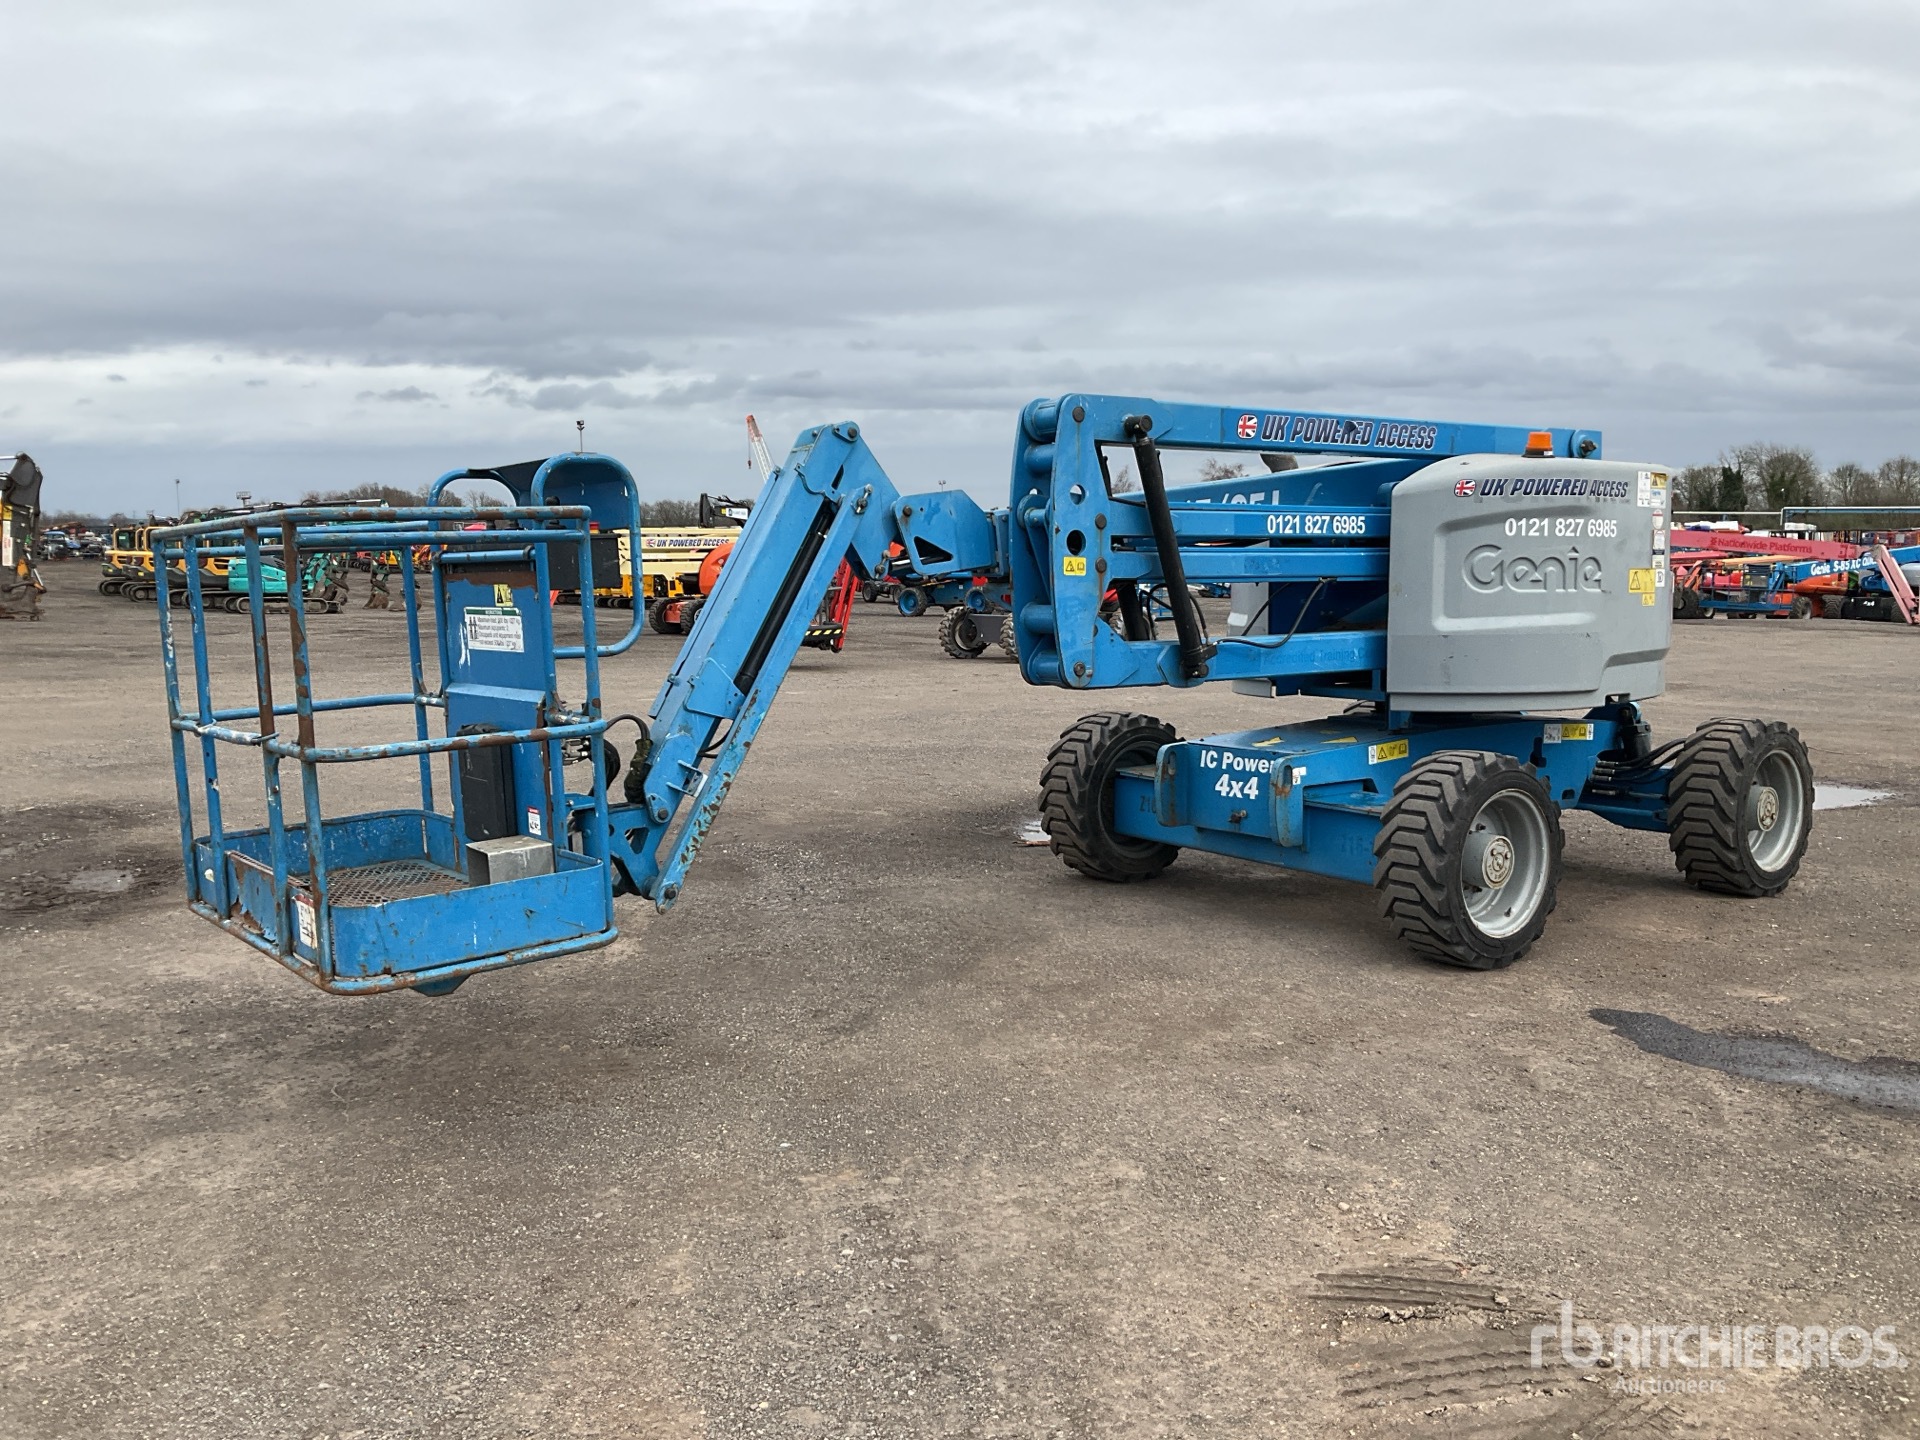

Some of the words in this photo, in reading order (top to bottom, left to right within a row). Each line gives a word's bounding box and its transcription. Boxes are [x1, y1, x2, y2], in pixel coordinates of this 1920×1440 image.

[1261, 415, 1290, 441] UK
[1290, 417, 1374, 446] POWERED
[1374, 422, 1437, 450] ACCESS
[1479, 478, 1509, 496] UK
[1509, 478, 1589, 496] POWERED
[1589, 479, 1628, 498] ACCESS
[1267, 514, 1300, 534] 0121
[1304, 515, 1330, 534] 827
[1332, 515, 1365, 534] 6985
[1504, 517, 1549, 537] 0121
[1555, 518, 1583, 537] 827
[1587, 519, 1617, 537] 6985
[656, 539, 667, 547] UK
[668, 539, 701, 547] POWERED
[1718, 538, 1767, 551] Nationwide
[1769, 542, 1813, 554] Platforms
[1462, 543, 1602, 594] Genie
[1810, 563, 1831, 576] Genie
[1200, 750, 1218, 769] IC
[1214, 773, 1259, 799] 4x4
